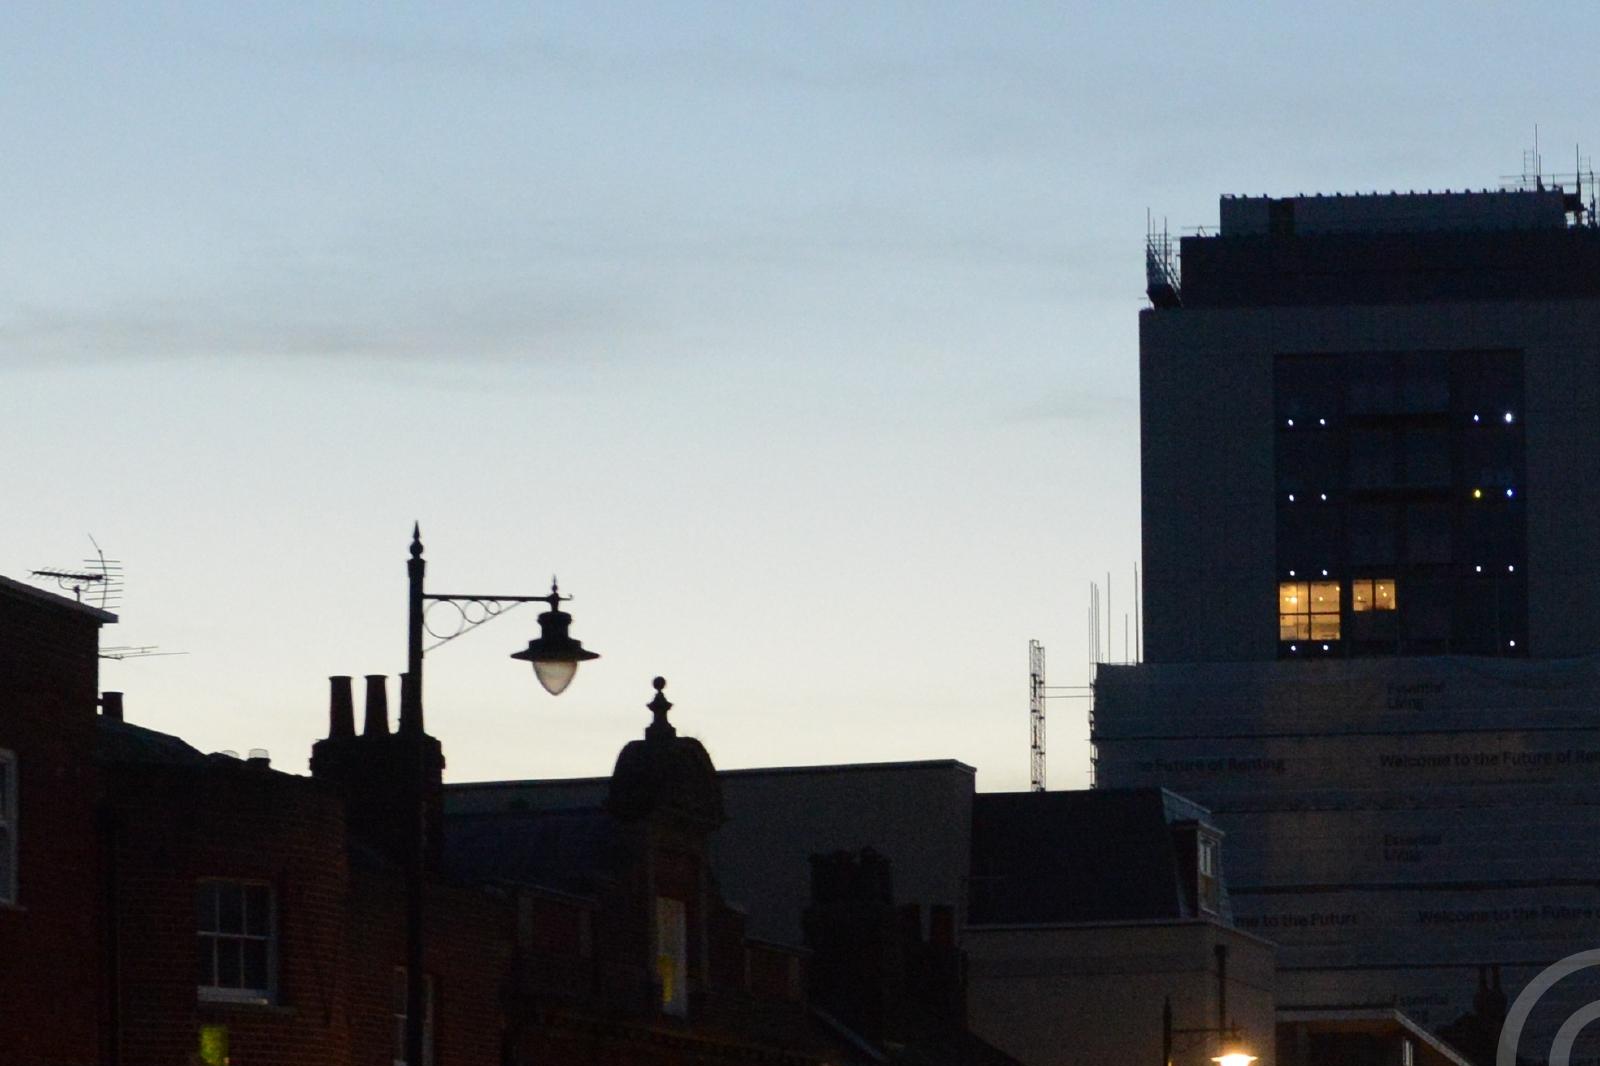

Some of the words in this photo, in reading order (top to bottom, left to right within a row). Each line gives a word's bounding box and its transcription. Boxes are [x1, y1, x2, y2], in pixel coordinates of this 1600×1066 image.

[1156, 758, 1204, 772] Future
[1228, 757, 1286, 775] Renting
[1380, 755, 1451, 768] Welcome
[1453, 754, 1471, 766] to
[1474, 753, 1499, 766] the
[1502, 751, 1552, 765] Future
[1555, 750, 1572, 764] of
[1263, 914, 1281, 928] to
[1283, 913, 1309, 928] the
[1417, 910, 1489, 924] Welcome
[1492, 909, 1511, 922] to
[1513, 908, 1537, 921] the
[1541, 905, 1592, 920] Future
